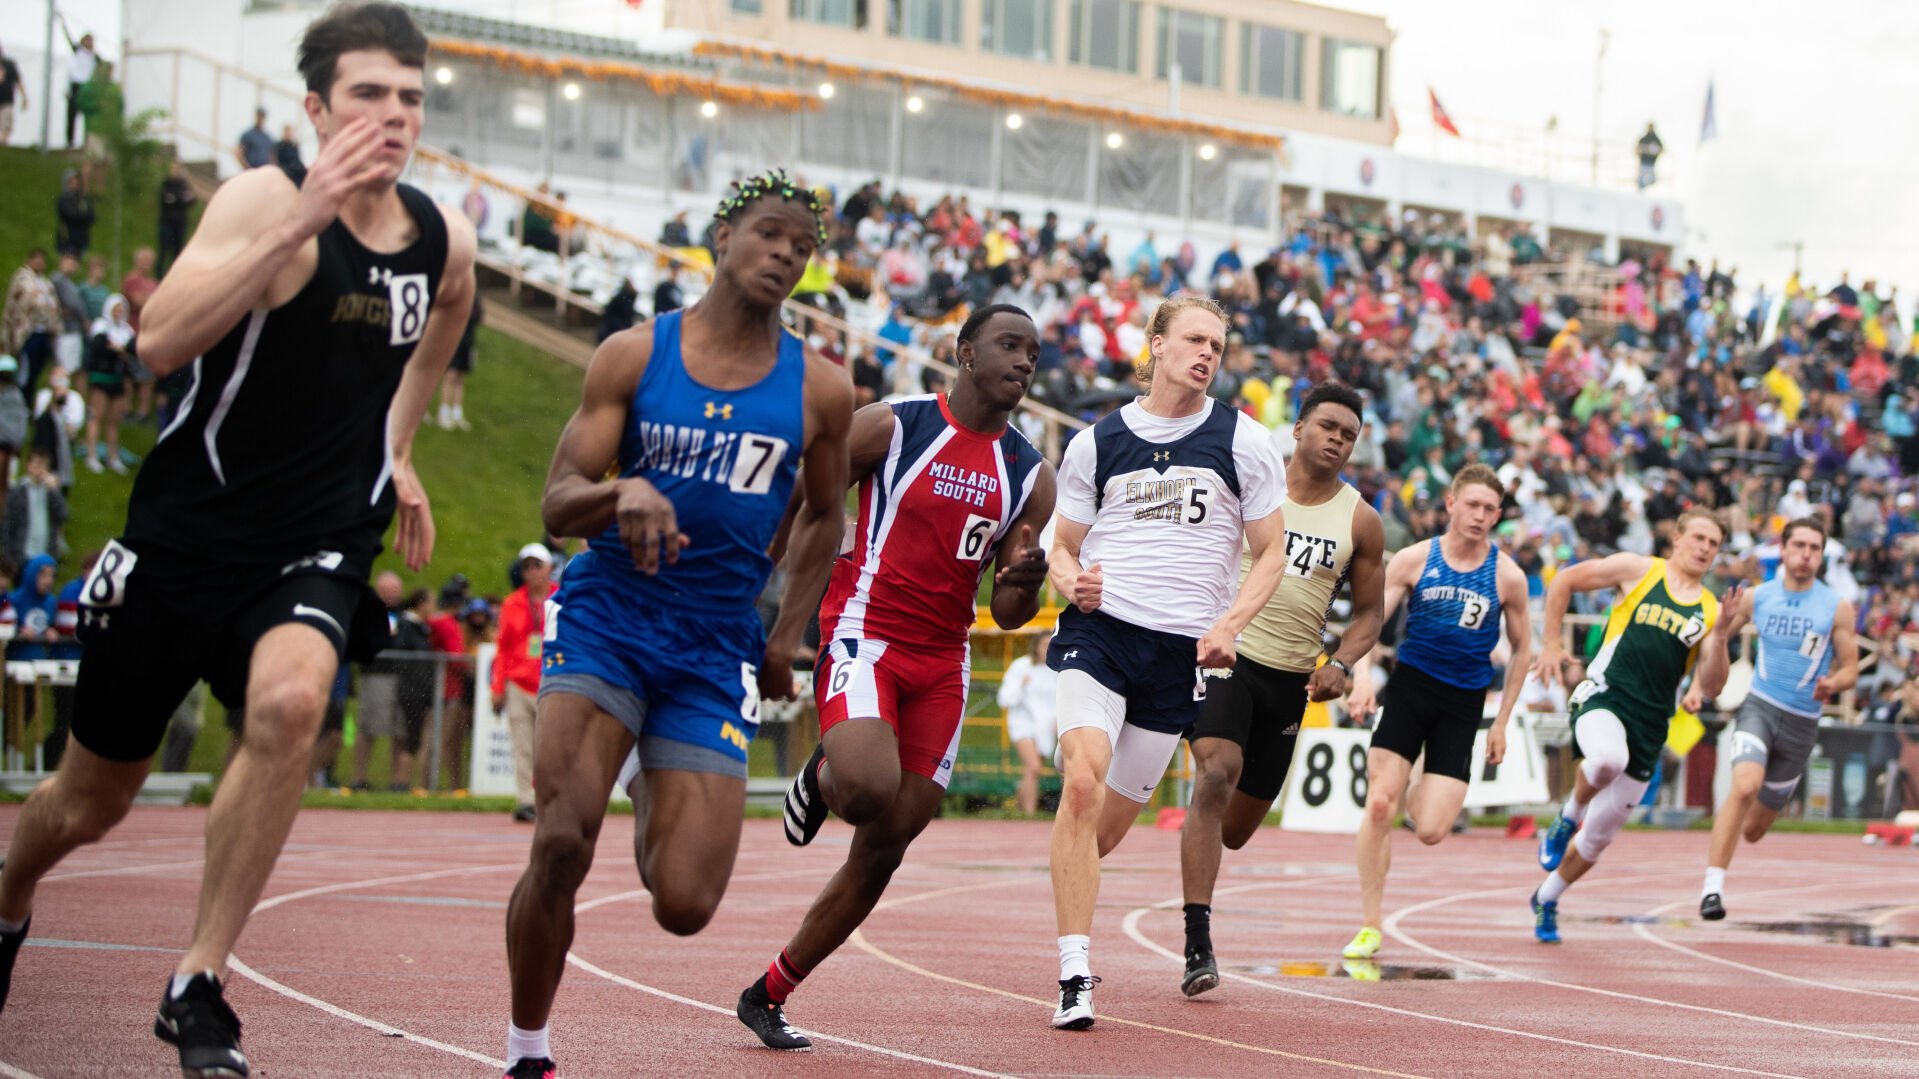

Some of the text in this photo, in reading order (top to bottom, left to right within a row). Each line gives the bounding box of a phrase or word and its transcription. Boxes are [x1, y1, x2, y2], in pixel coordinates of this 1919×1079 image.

[401, 280, 420, 338] 8
[635, 421, 706, 478] NORTH
[743, 439, 774, 488] 7
[928, 461, 998, 493] MILLARD
[933, 480, 987, 507] SOUTH
[1187, 488, 1208, 524] 5
[964, 520, 991, 557] 6
[89, 547, 124, 605] 8
[1293, 545, 1314, 576] 4
[1421, 585, 1456, 602] SOUTH
[1464, 602, 1482, 627] 3
[1684, 622, 1703, 645] 2
[1808, 636, 1819, 657] 1
[832, 660, 853, 693] 6
